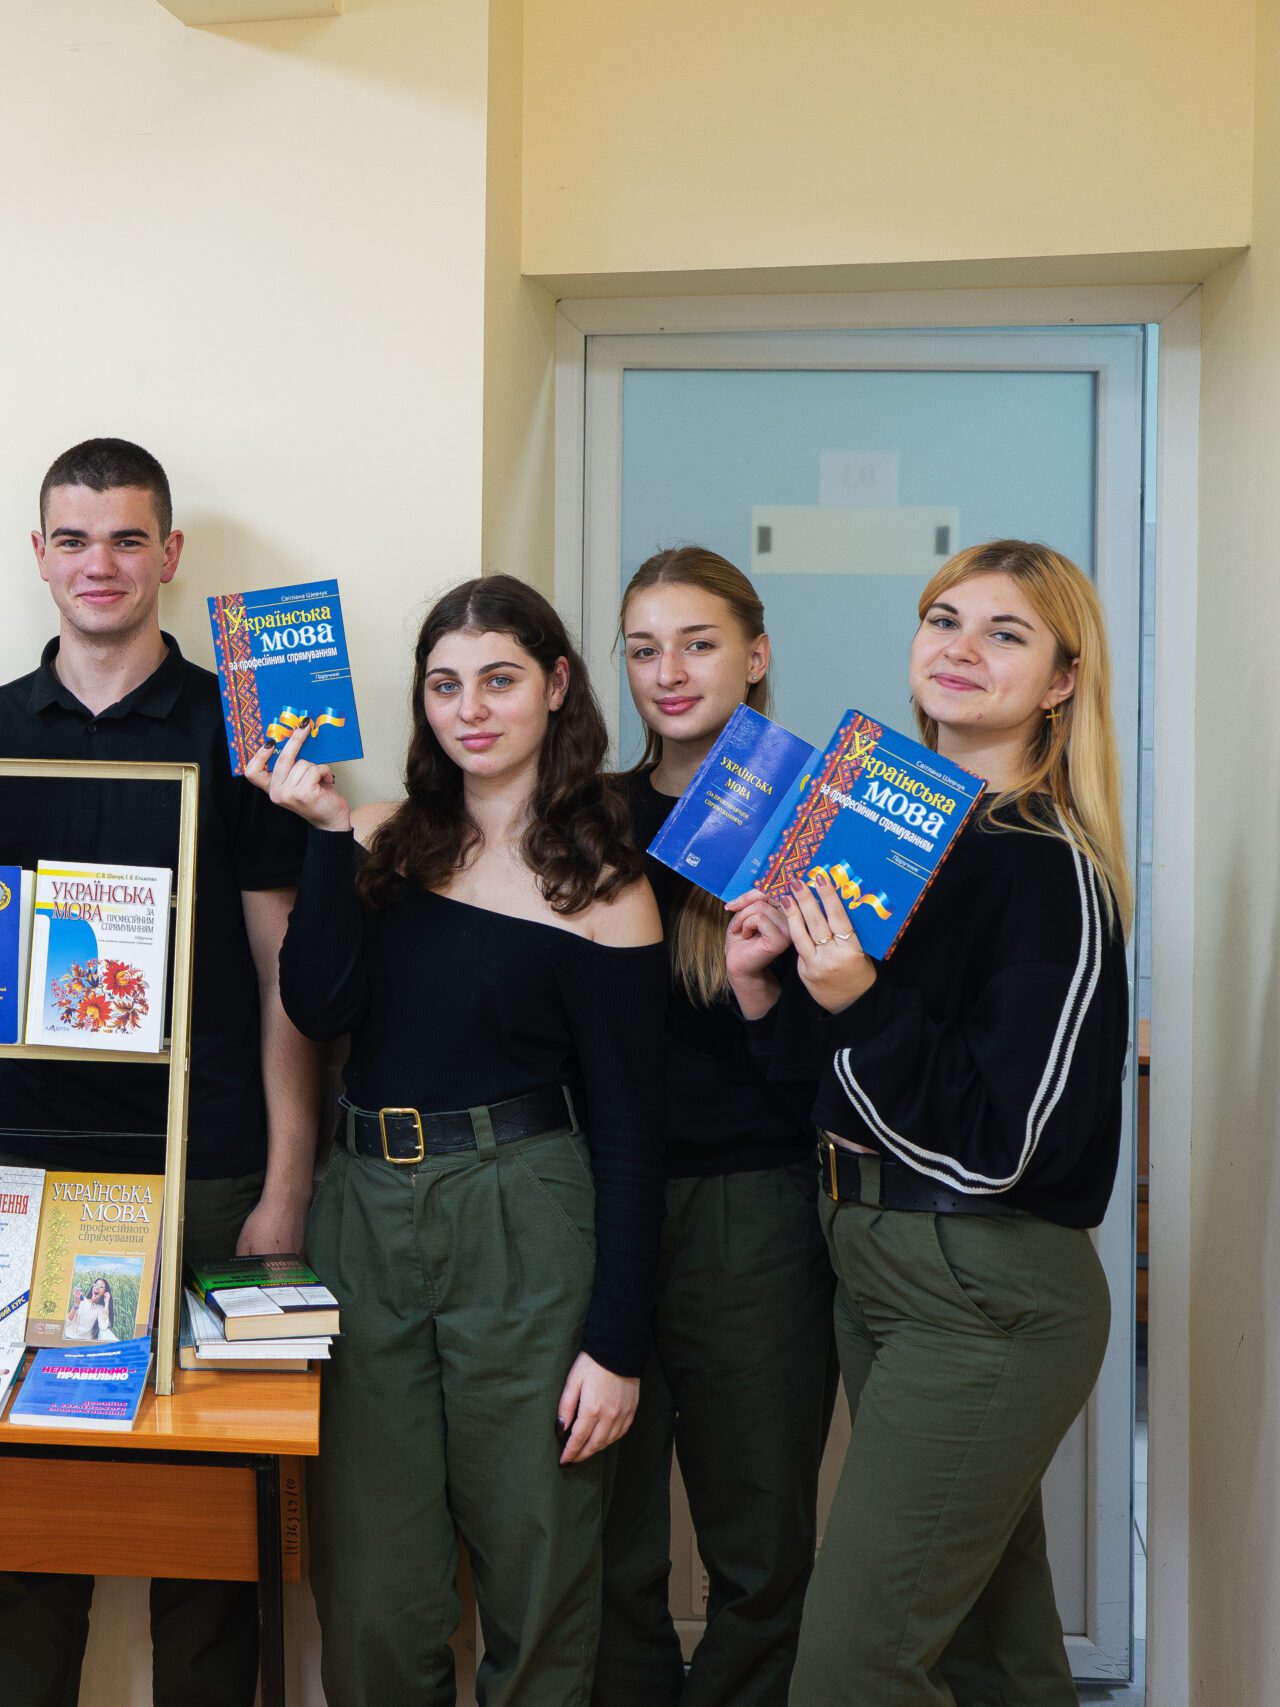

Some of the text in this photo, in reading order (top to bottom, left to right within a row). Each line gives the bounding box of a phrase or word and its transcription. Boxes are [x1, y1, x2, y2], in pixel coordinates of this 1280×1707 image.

[222, 605, 332, 637] Українська
[239, 653, 286, 671] професійним
[286, 646, 338, 664] спрямуванням
[720, 756, 774, 796] УКРАЇНСЬКА
[843, 730, 957, 816] Українська
[916, 760, 967, 791] Світлана Шевчук
[725, 777, 751, 800] МОВА
[819, 783, 935, 853] за професійним спрямуванням
[52, 880, 155, 905] УКРАЇНСЬКА
[51, 901, 103, 922] МОВА
[106, 914, 155, 925] ПРОФЕСІЙНИМ
[146, 908, 155, 916] ЗА
[101, 922, 154, 934] СПРЯМУВАННЯМ
[52, 1180, 153, 1204] УКРАЇНСЬКА
[80, 1203, 150, 1224] МОВА
[79, 1222, 150, 1234] професійного
[78, 1234, 144, 1245] спрямування
[10, 1295, 27, 1311] КУРС
[41, 1365, 128, 1374] НЕПРАВИЛЬНО
[56, 1371, 129, 1381] ПРАВИЛЬНО
